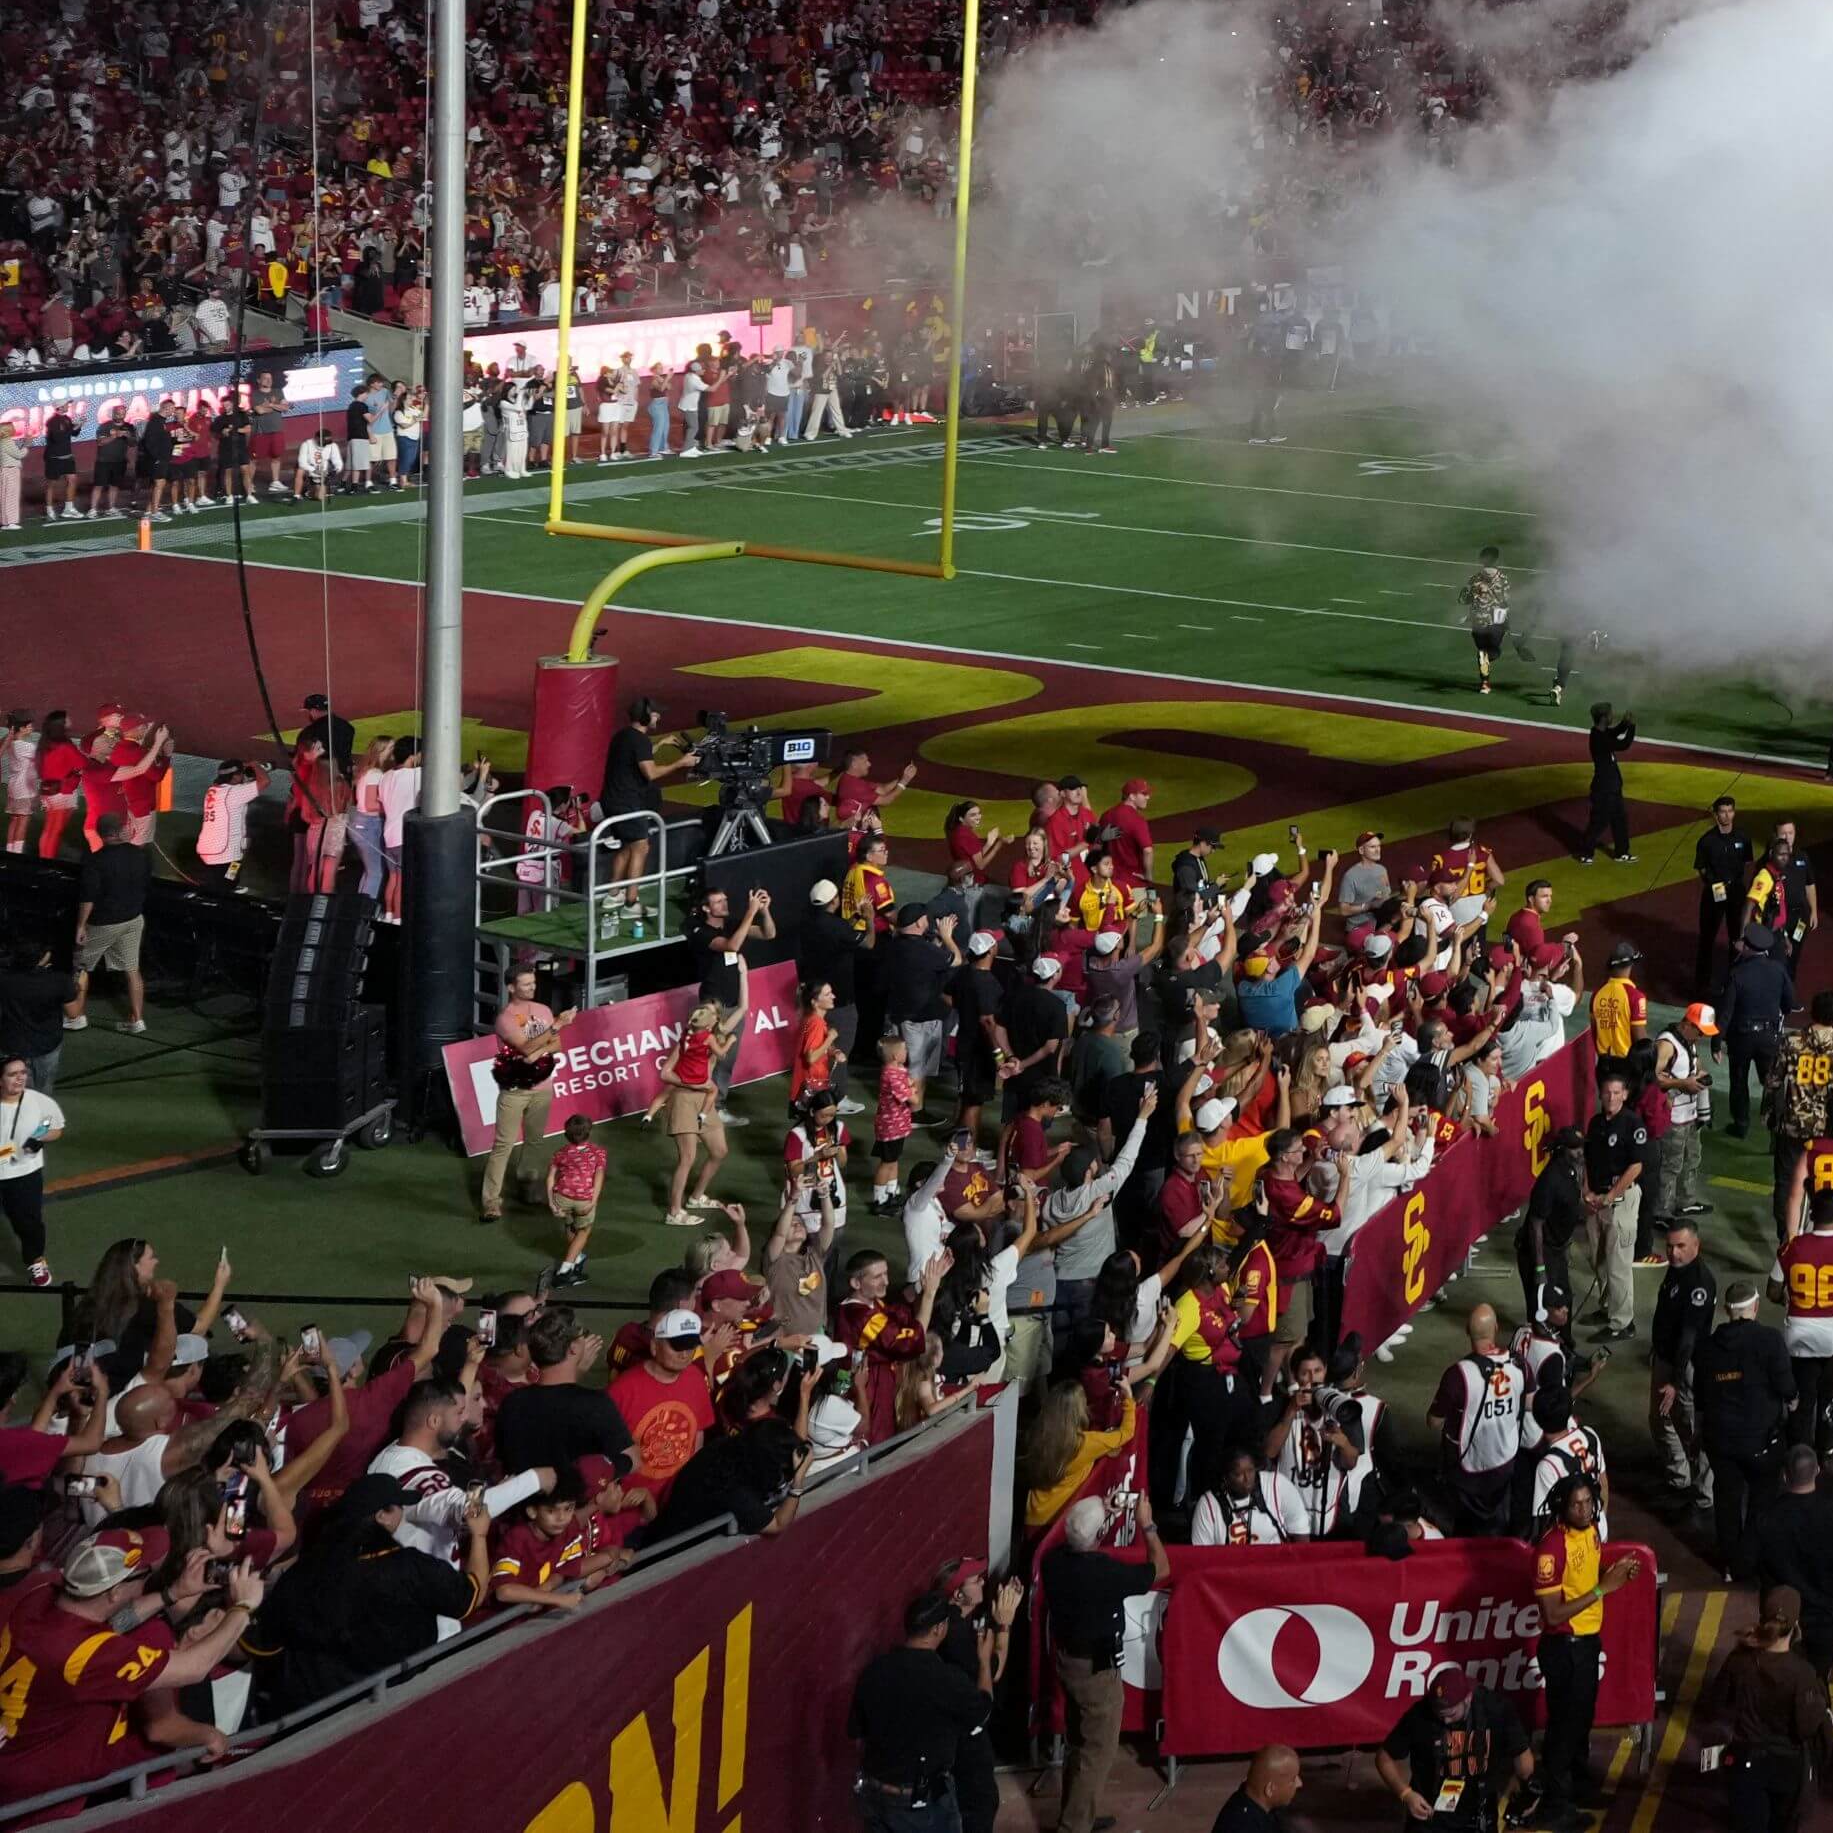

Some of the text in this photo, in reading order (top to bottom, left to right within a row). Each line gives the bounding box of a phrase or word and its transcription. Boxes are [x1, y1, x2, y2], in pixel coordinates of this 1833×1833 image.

[463, 295, 477, 307] 24
[752, 298, 773, 314] NW
[553, 1062, 641, 1098] RESORT
[1796, 1053, 1831, 1086] 88
[1440, 1121, 1456, 1142] 33
[1403, 1190, 1431, 1305] SC
[1484, 1396, 1514, 1421] 051
[1388, 1595, 1544, 1647] Unite
[116, 1645, 164, 1684] 24
